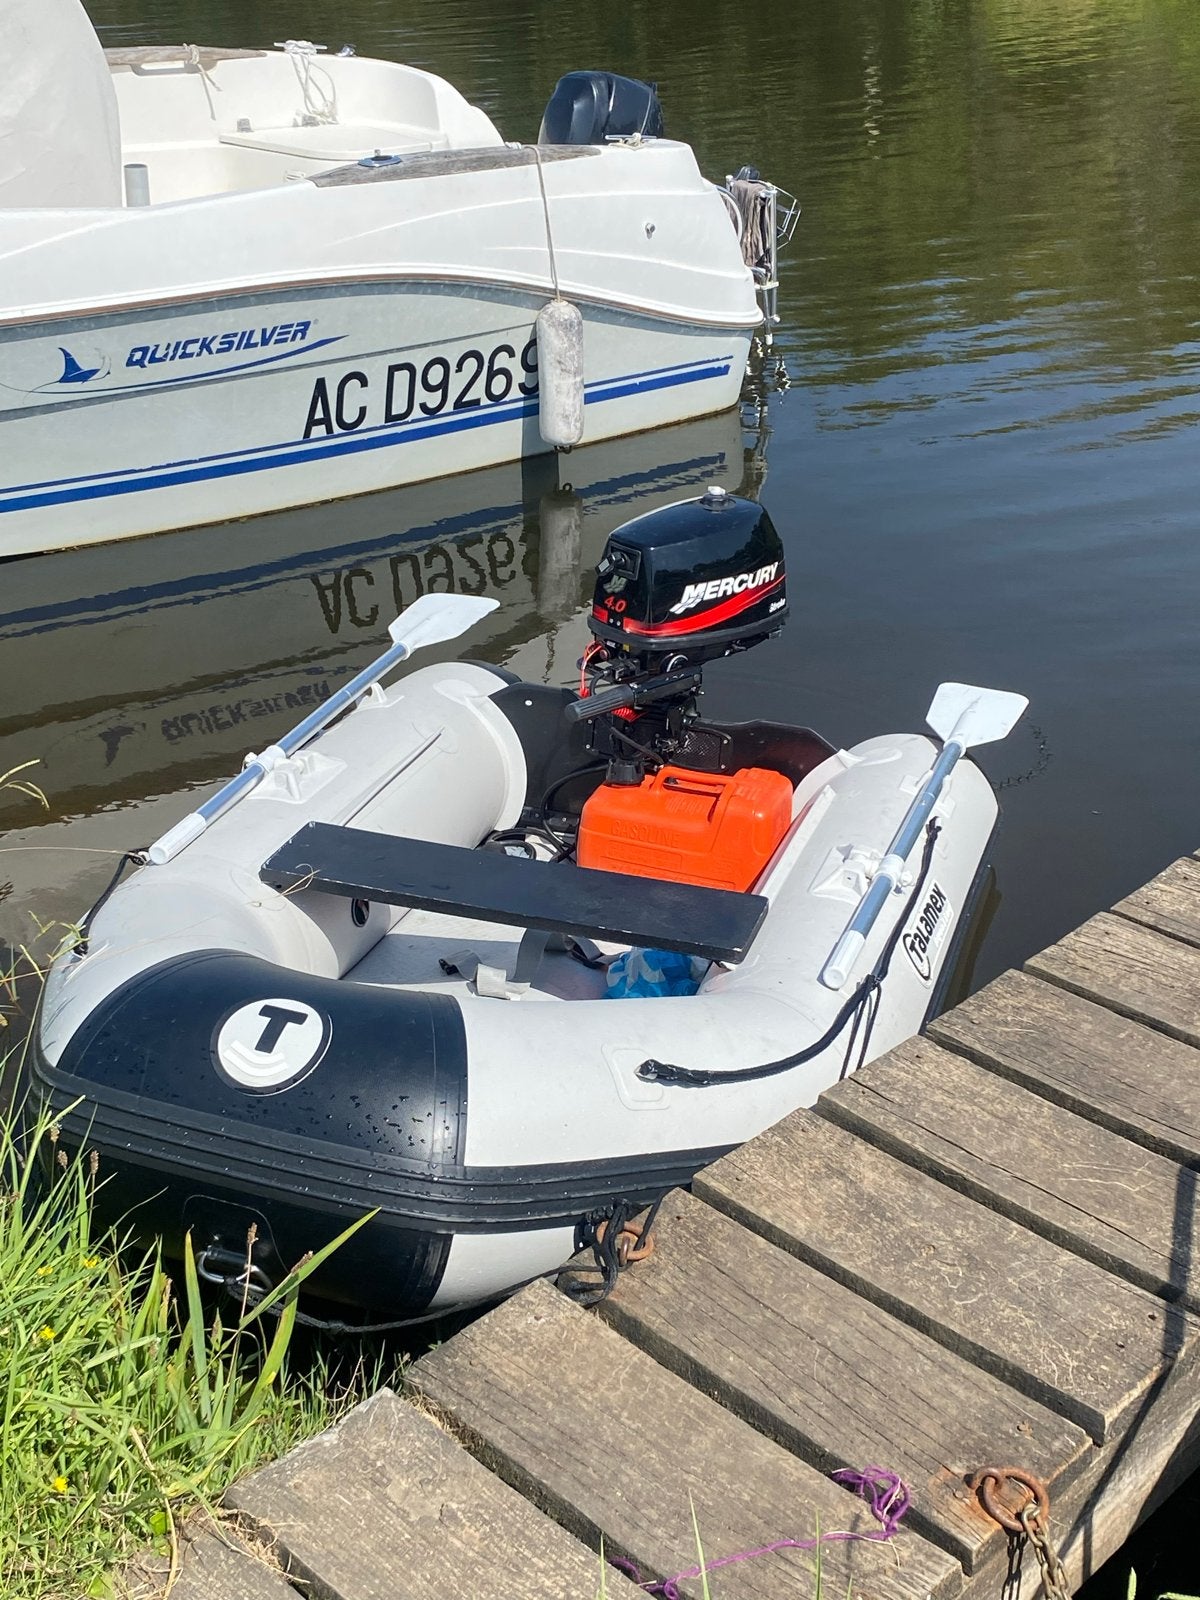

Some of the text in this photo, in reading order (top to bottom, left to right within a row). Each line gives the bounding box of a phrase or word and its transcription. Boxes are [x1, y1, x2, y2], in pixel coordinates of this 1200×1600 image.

[126, 321, 312, 369] QUICKSILVER
[302, 371, 369, 439] AC
[604, 596, 626, 612] 4.0
[669, 562, 779, 614] MERCURY
[611, 820, 680, 849] GASOLINE
[255, 1004, 309, 1054] T
